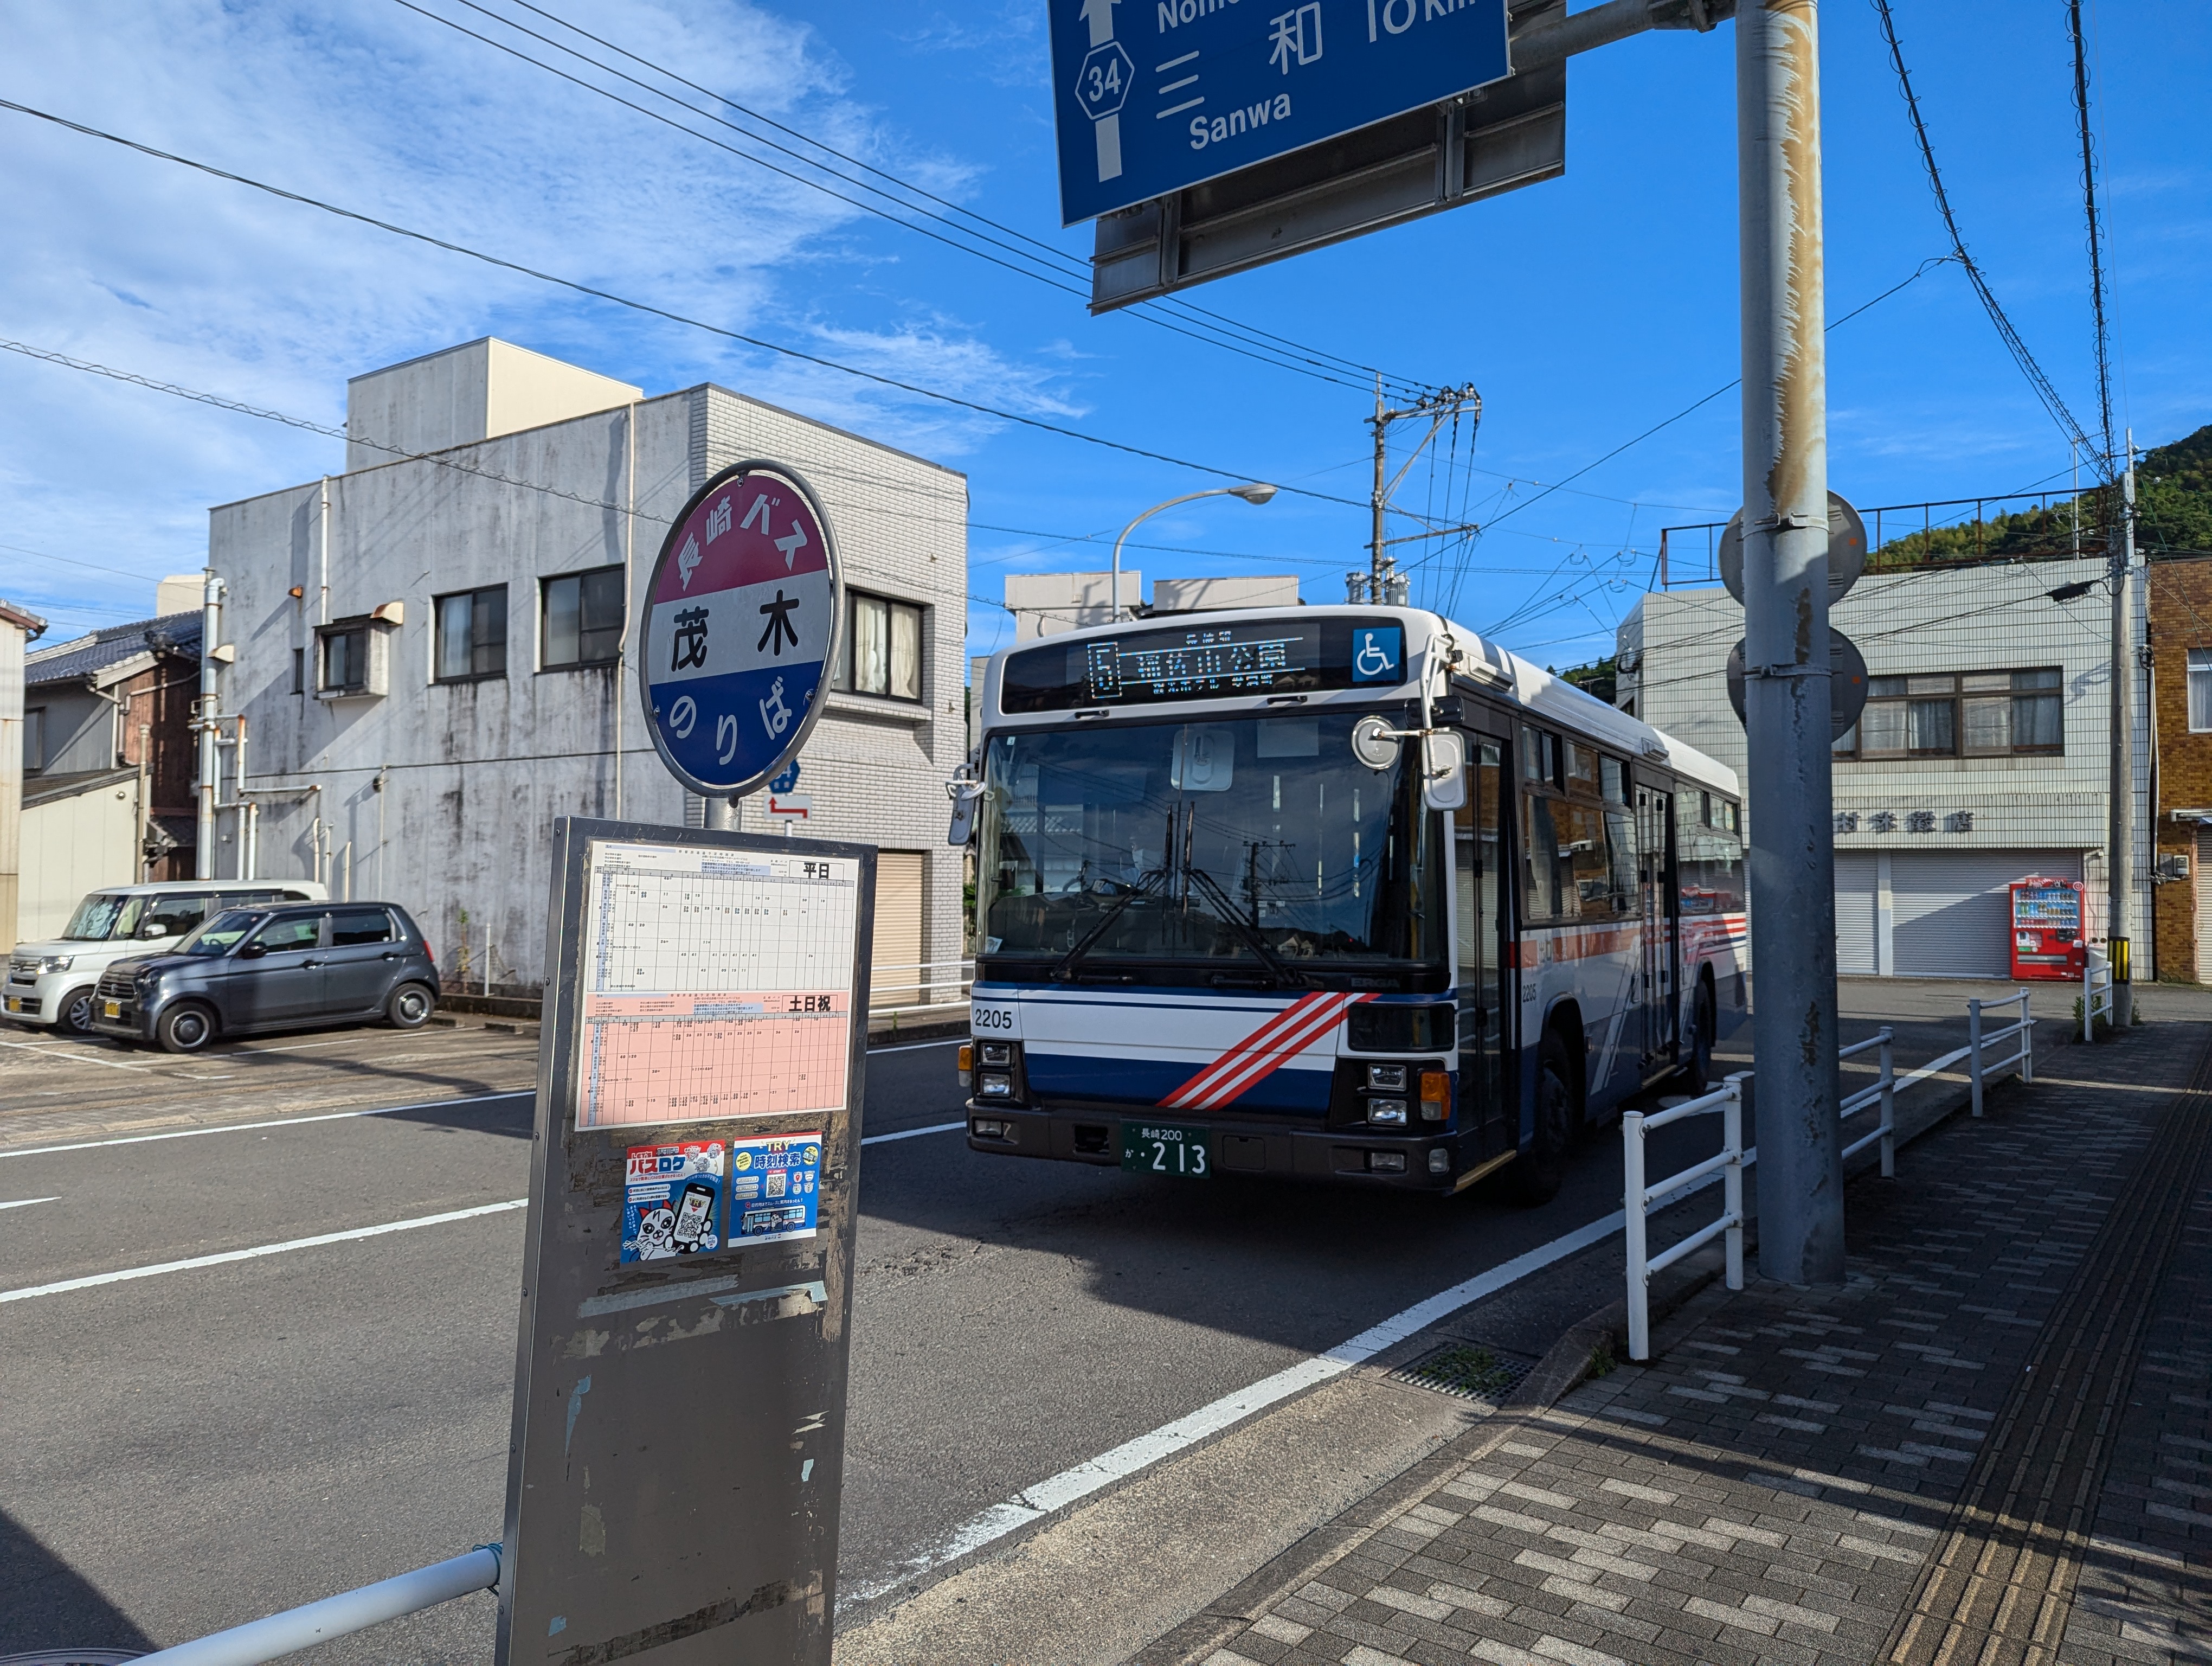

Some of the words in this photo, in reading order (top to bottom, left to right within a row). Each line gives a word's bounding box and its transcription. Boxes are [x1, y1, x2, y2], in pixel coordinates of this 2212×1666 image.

[1088, 58, 1121, 102] 34
[1189, 93, 1291, 150] Sanwa
[671, 589, 800, 672] 茂木
[670, 676, 793, 765] のりば
[803, 862, 829, 879] 平日
[1351, 978, 1400, 988] ERGA
[1522, 983, 1536, 1003] 2205
[789, 996, 831, 1012] 土日祝
[975, 1008, 1012, 1029] 2205
[1141, 1127, 1182, 1141] 長崎200
[766, 1140, 791, 1152] TRY
[1125, 1148, 1134, 1158] か
[629, 1156, 686, 1175] バスロケ
[754, 1152, 801, 1169] 時刻検索
[689, 1197, 706, 1207] TRY
